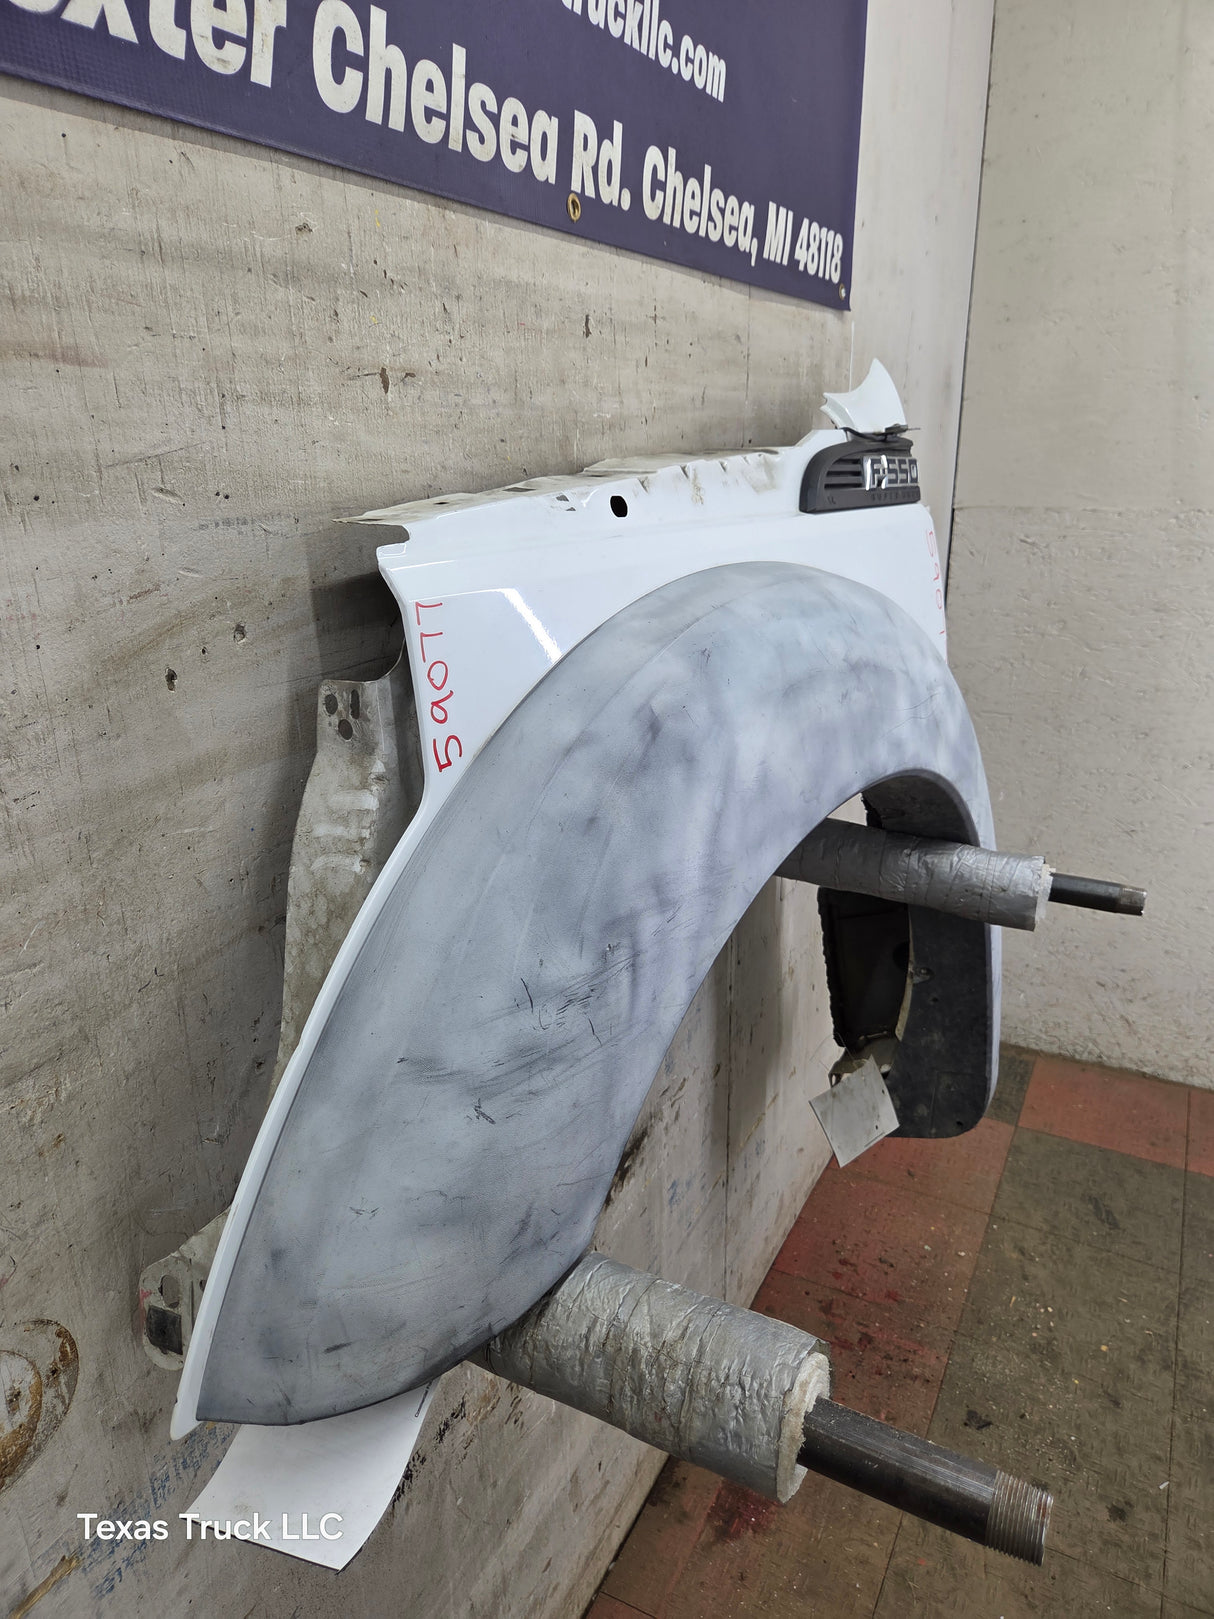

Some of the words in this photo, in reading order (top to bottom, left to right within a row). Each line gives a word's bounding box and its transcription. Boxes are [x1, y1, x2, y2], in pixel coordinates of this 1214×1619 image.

[561, 0, 727, 103] uckllc.com
[8, 0, 288, 88] ter
[312, 0, 559, 184] Chelsea
[570, 109, 631, 211] Rd.
[642, 145, 758, 267] Chelsea,
[763, 200, 794, 266] MI
[794, 217, 843, 284] 48118
[415, 601, 463, 772] 59077
